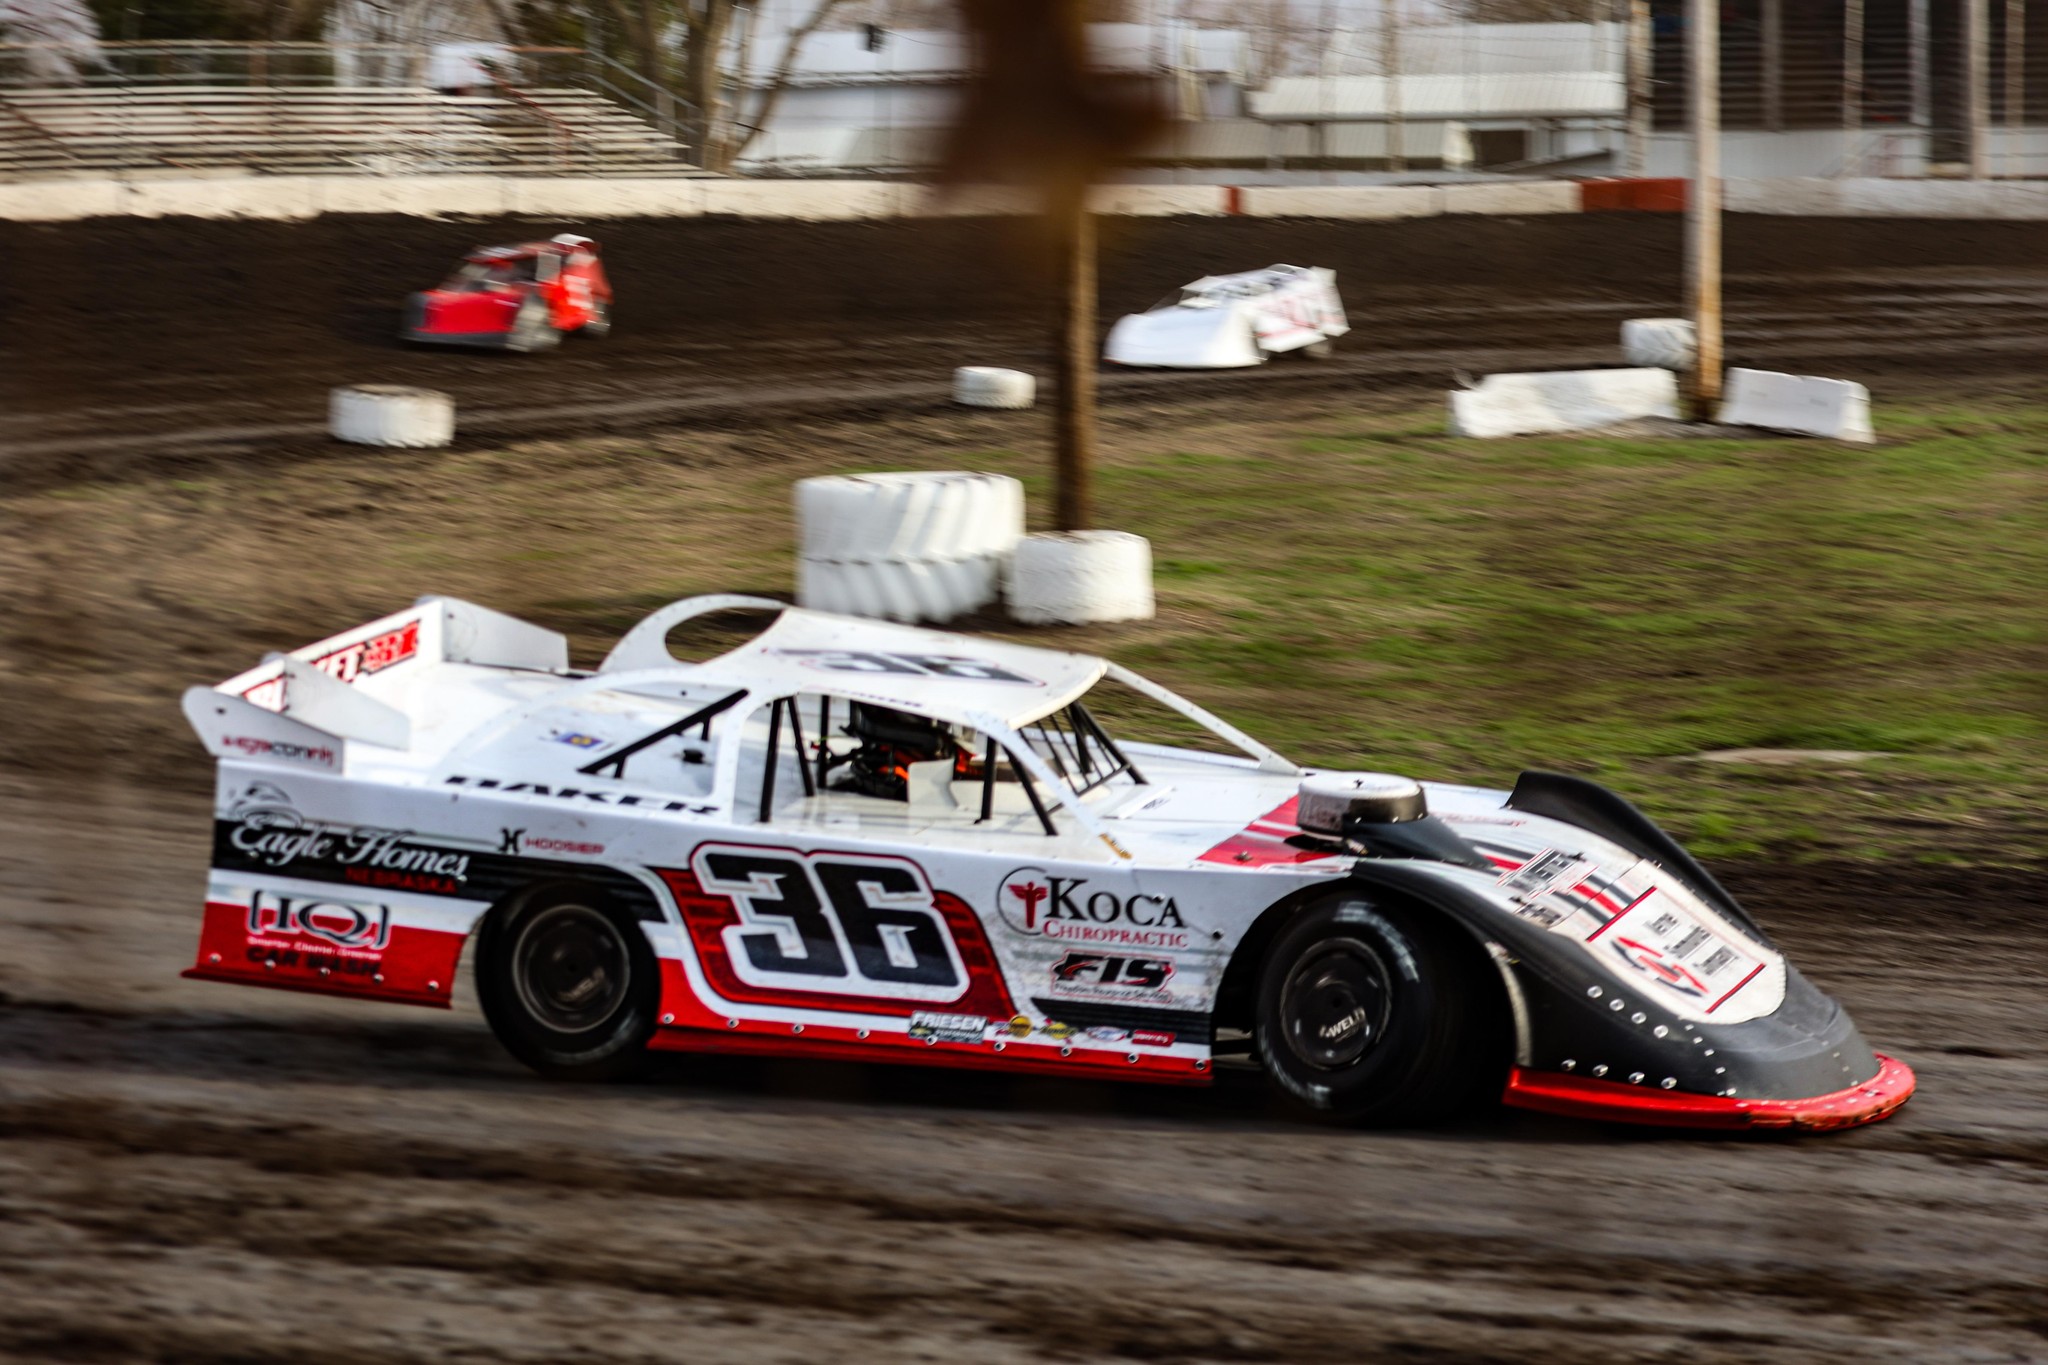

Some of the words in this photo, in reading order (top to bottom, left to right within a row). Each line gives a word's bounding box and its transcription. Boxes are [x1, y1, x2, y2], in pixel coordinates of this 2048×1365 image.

[231, 815, 333, 866] Eagle
[336, 826, 470, 878] Homes
[525, 836, 605, 855] HOOSIER
[702, 851, 963, 989] 36
[1044, 876, 1188, 929] KOCA
[1042, 919, 1189, 948] CHIROPRACTIC
[1053, 952, 1173, 989] FIS
[911, 1011, 988, 1032] FRIESEN
